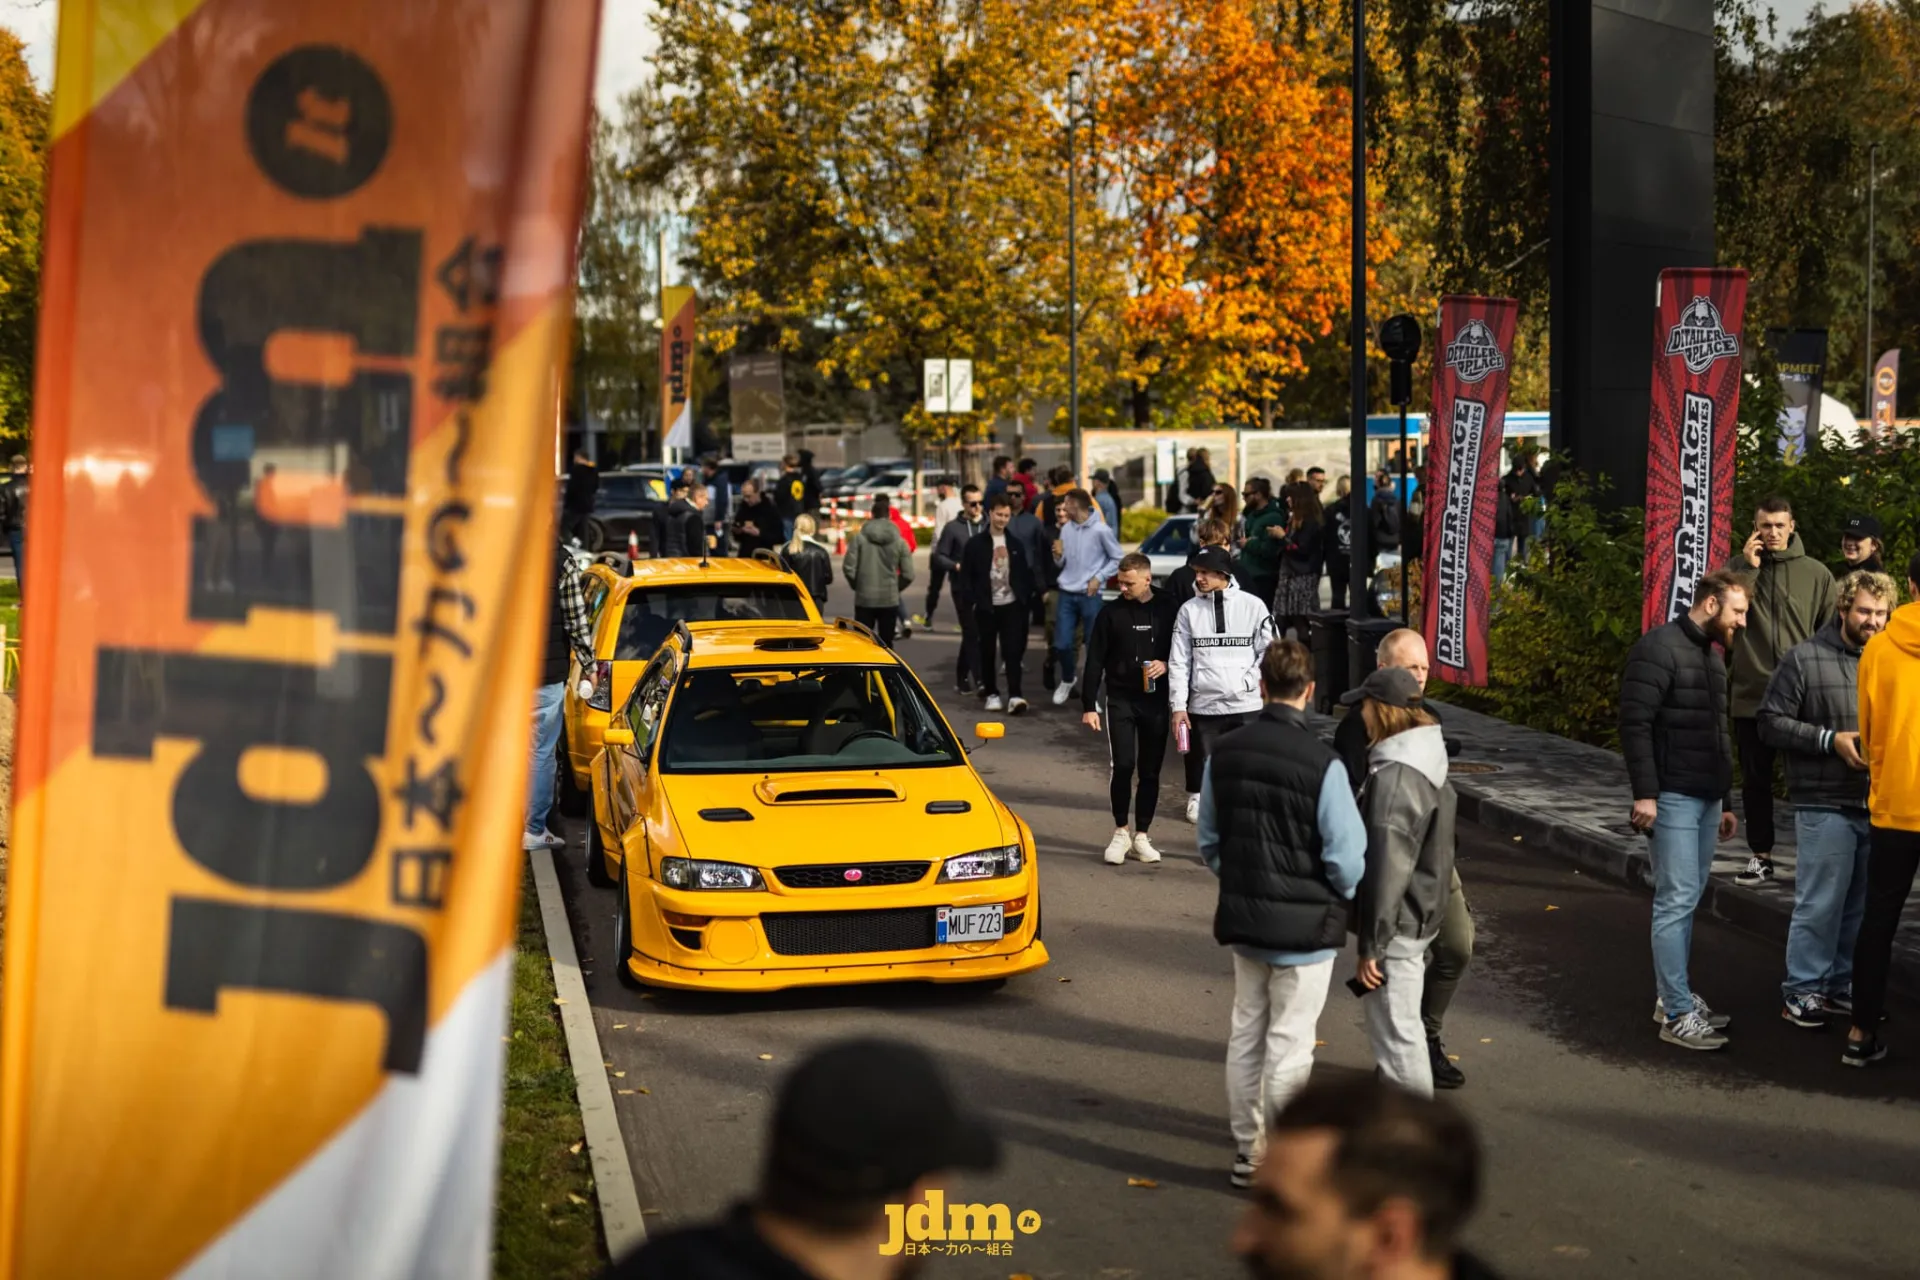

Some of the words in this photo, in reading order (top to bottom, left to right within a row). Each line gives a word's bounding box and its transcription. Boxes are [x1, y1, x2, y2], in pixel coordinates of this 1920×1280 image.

[1447, 345, 1497, 361] DETAILER
[1692, 340, 1735, 363] PLACE
[1465, 357, 1502, 373] PLACE
[1463, 405, 1482, 487] PRIEMONĖS
[1683, 398, 1699, 529] PLACE
[1439, 512, 1458, 661] DETAILER
[1449, 402, 1470, 509] PLACE
[1674, 530, 1695, 616] ILER
[1195, 638, 1220, 647] SQUAD
[1222, 637, 1249, 646] FUTURE
[948, 914, 976, 935] MUF
[978, 912, 1001, 934] 223
